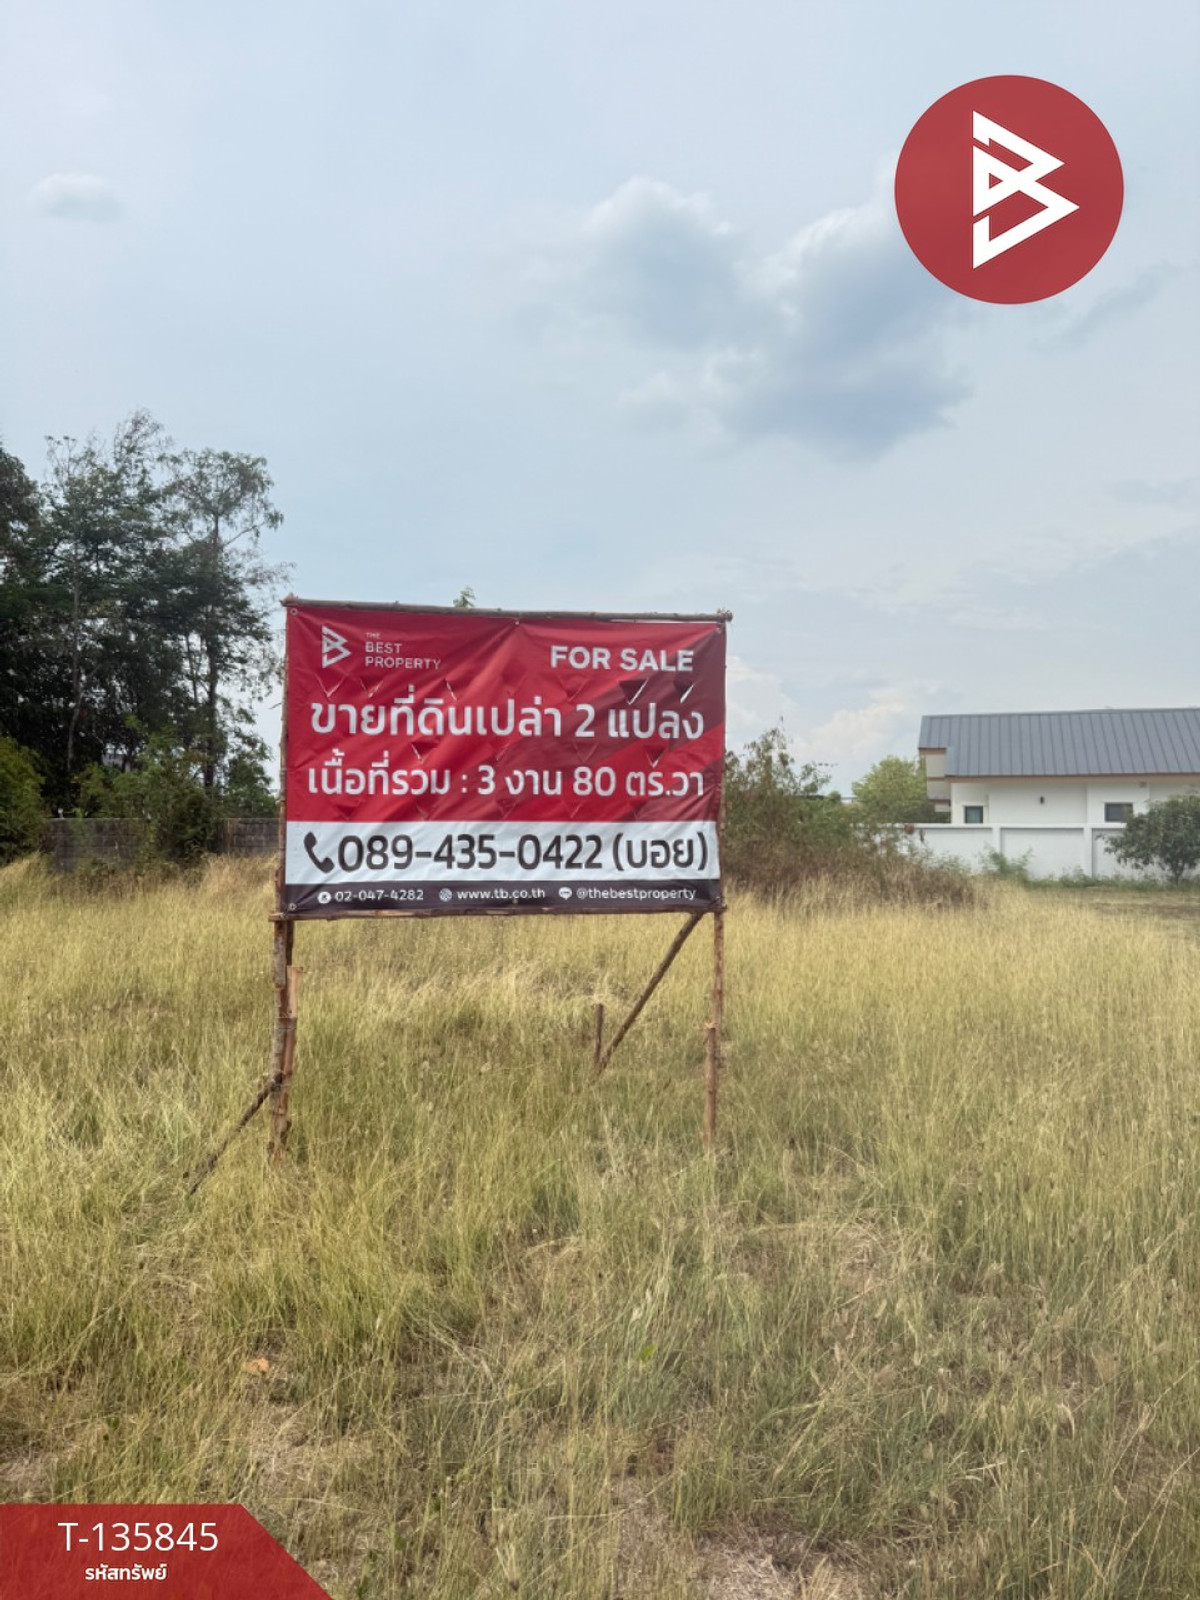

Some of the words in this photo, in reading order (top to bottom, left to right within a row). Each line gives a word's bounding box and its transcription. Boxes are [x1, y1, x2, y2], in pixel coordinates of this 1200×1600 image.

[365, 642, 402, 654] BEST
[551, 645, 611, 670] FOR
[620, 648, 694, 672] SALE
[365, 656, 441, 670] PROPERTY
[311, 684, 562, 737] ขายที่ดินเปล่า
[575, 704, 595, 737] 2
[608, 703, 704, 739] แปลง
[309, 748, 450, 795] เนื้อที่รวม
[478, 765, 496, 795] 3
[505, 769, 562, 795] งาน
[573, 766, 616, 796] 80
[626, 771, 704, 796] ตร.วา
[337, 833, 603, 872] 089-435-0422
[612, 832, 709, 872] (บอย)
[334, 889, 424, 902] 02-047-4282
[457, 887, 545, 899] www.tb.co.th
[576, 887, 696, 900] @thebestproperty
